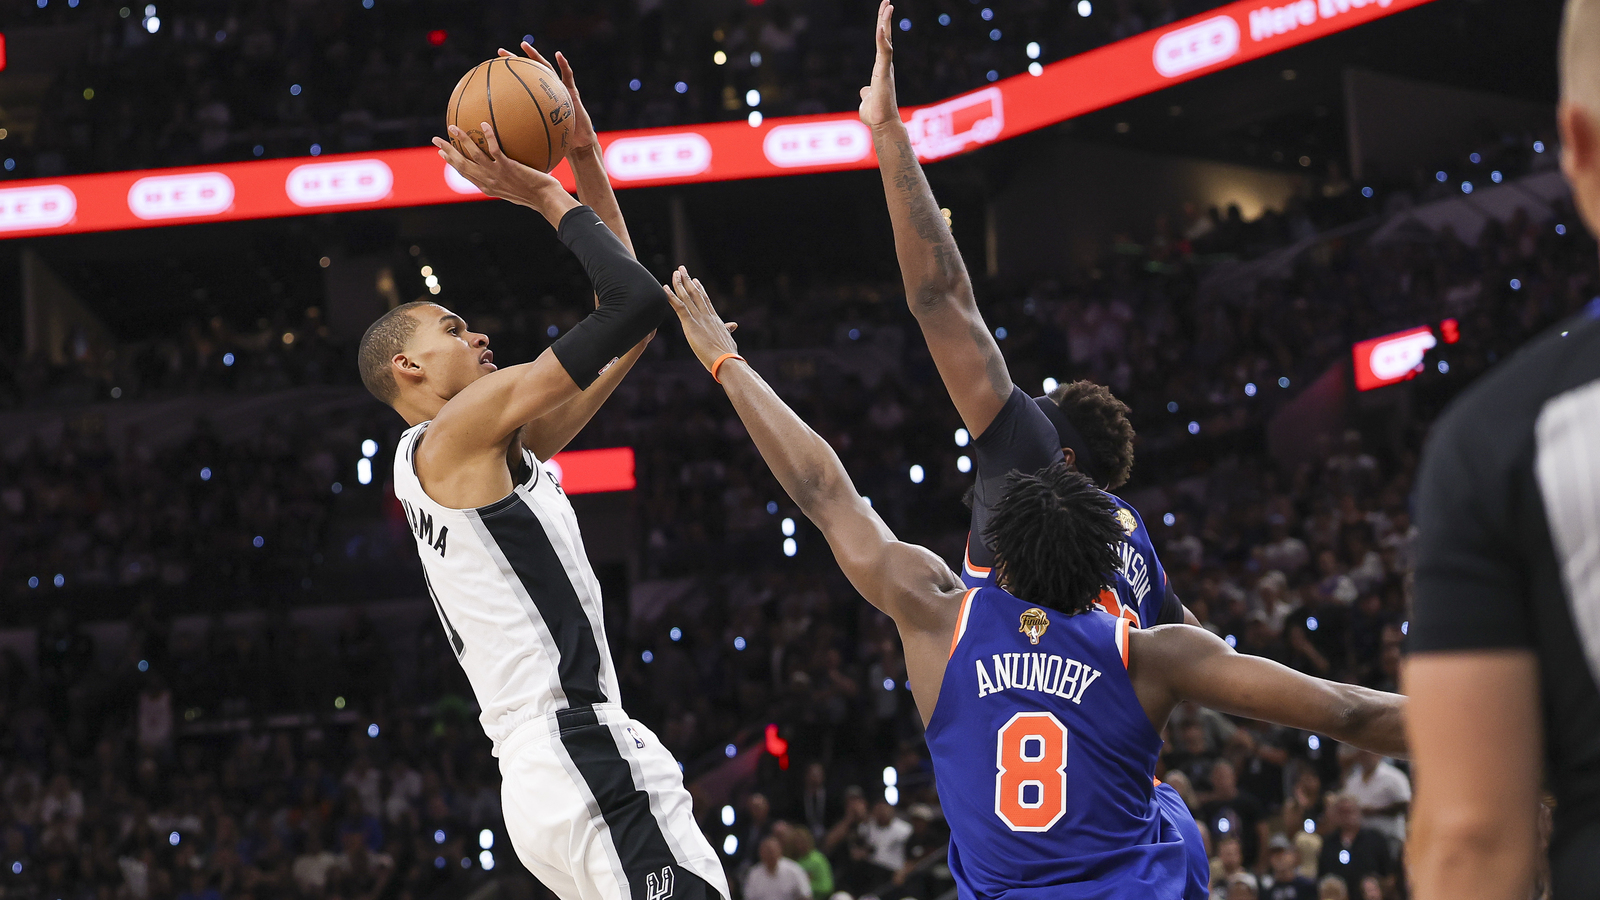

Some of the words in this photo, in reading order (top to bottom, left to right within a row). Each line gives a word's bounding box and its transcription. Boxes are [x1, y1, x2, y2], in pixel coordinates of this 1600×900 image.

[1249, 0, 1317, 42] Here
[1019, 613, 1049, 631] Finals
[975, 652, 1101, 705] ANUNOBY
[994, 711, 1068, 832] 8
